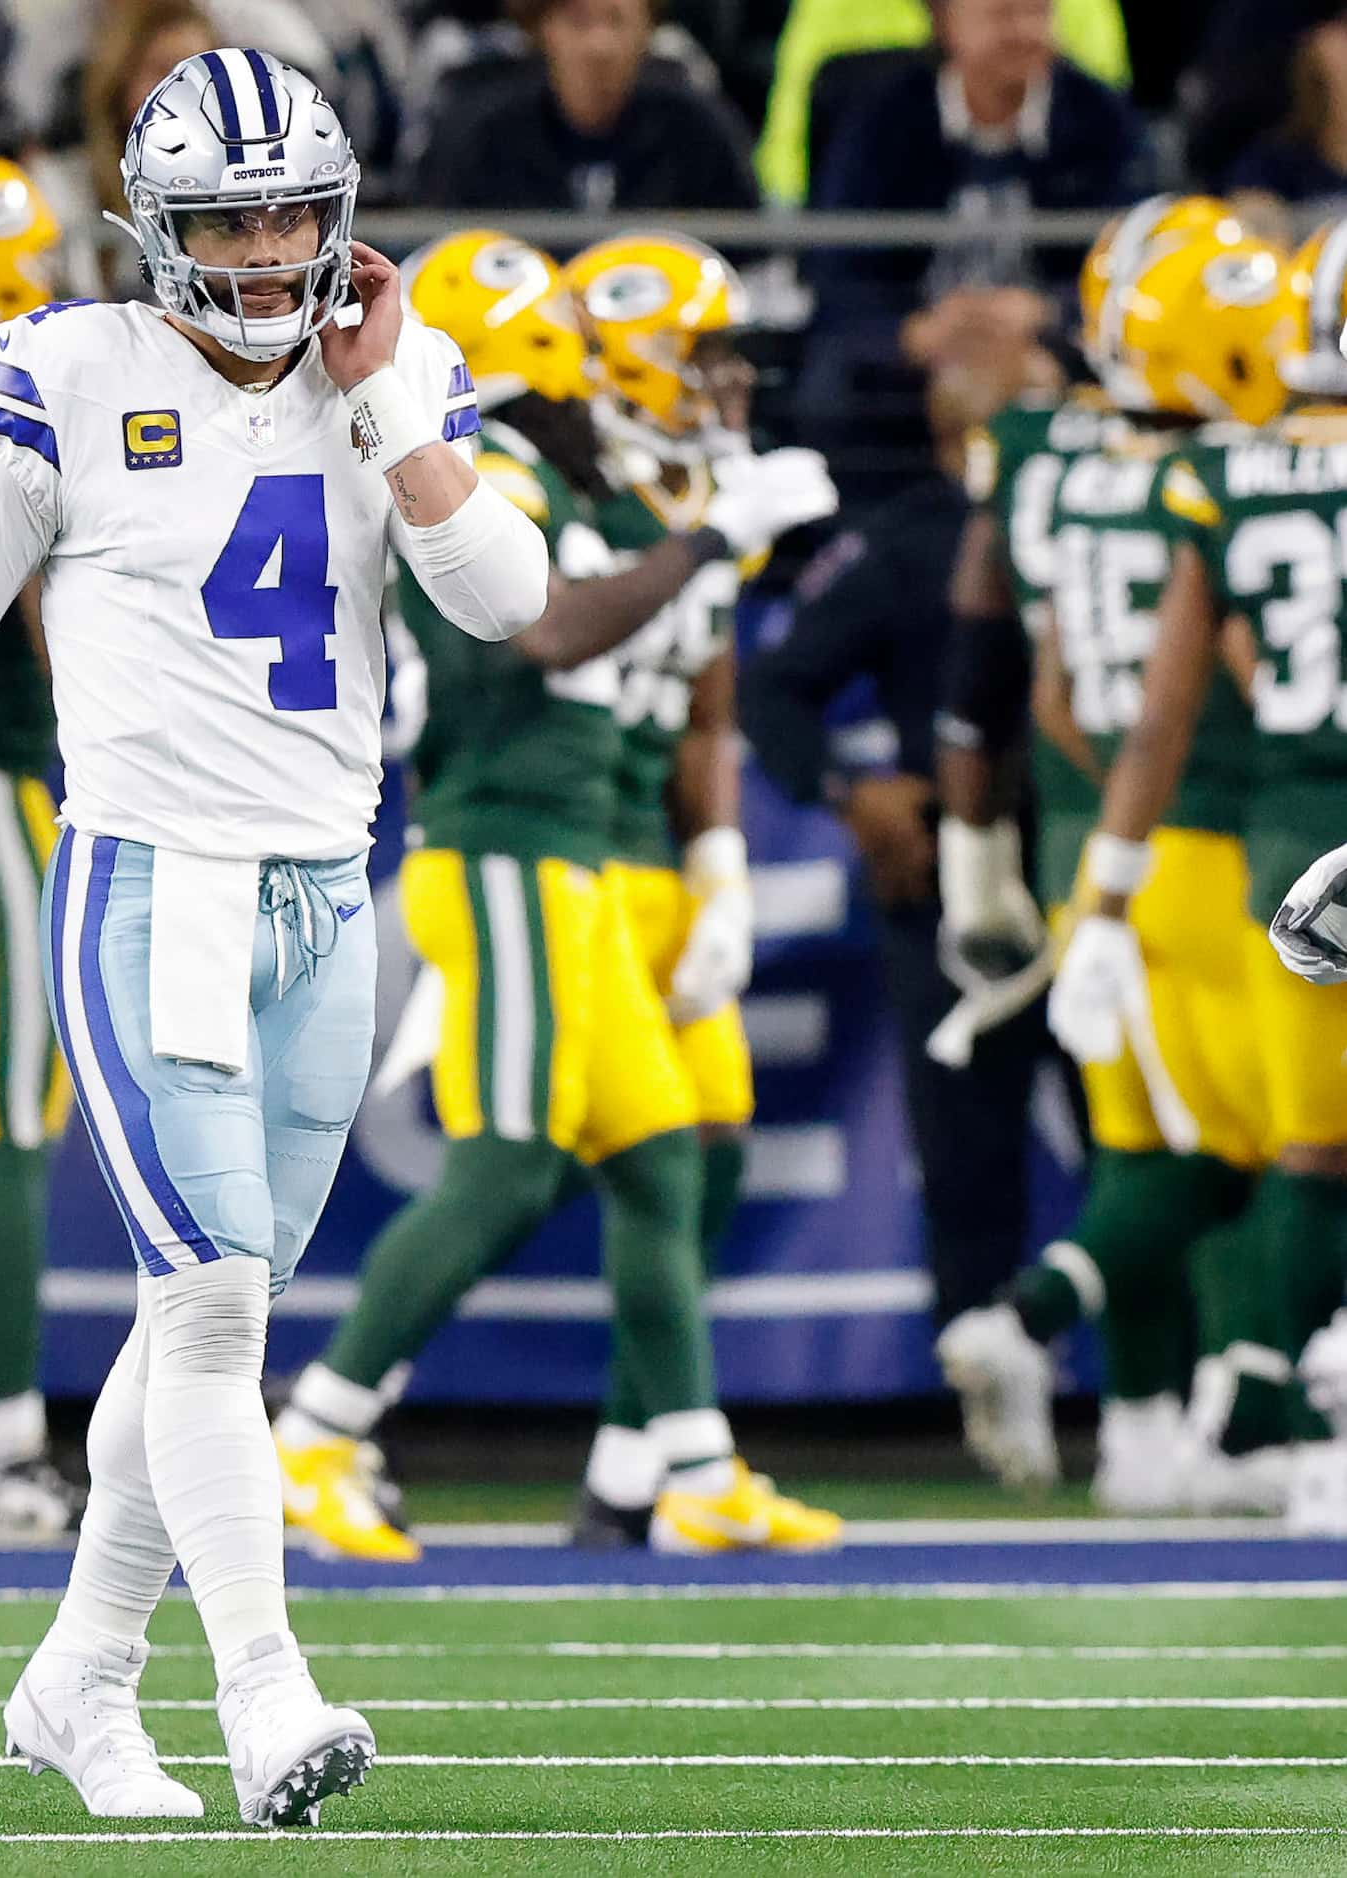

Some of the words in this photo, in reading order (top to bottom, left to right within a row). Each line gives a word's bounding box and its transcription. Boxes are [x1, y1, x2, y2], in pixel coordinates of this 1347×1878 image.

[233, 166, 286, 181] COWBOYS
[127, 413, 178, 455] C
[201, 474, 338, 711] 4
[1225, 508, 1347, 736] 3
